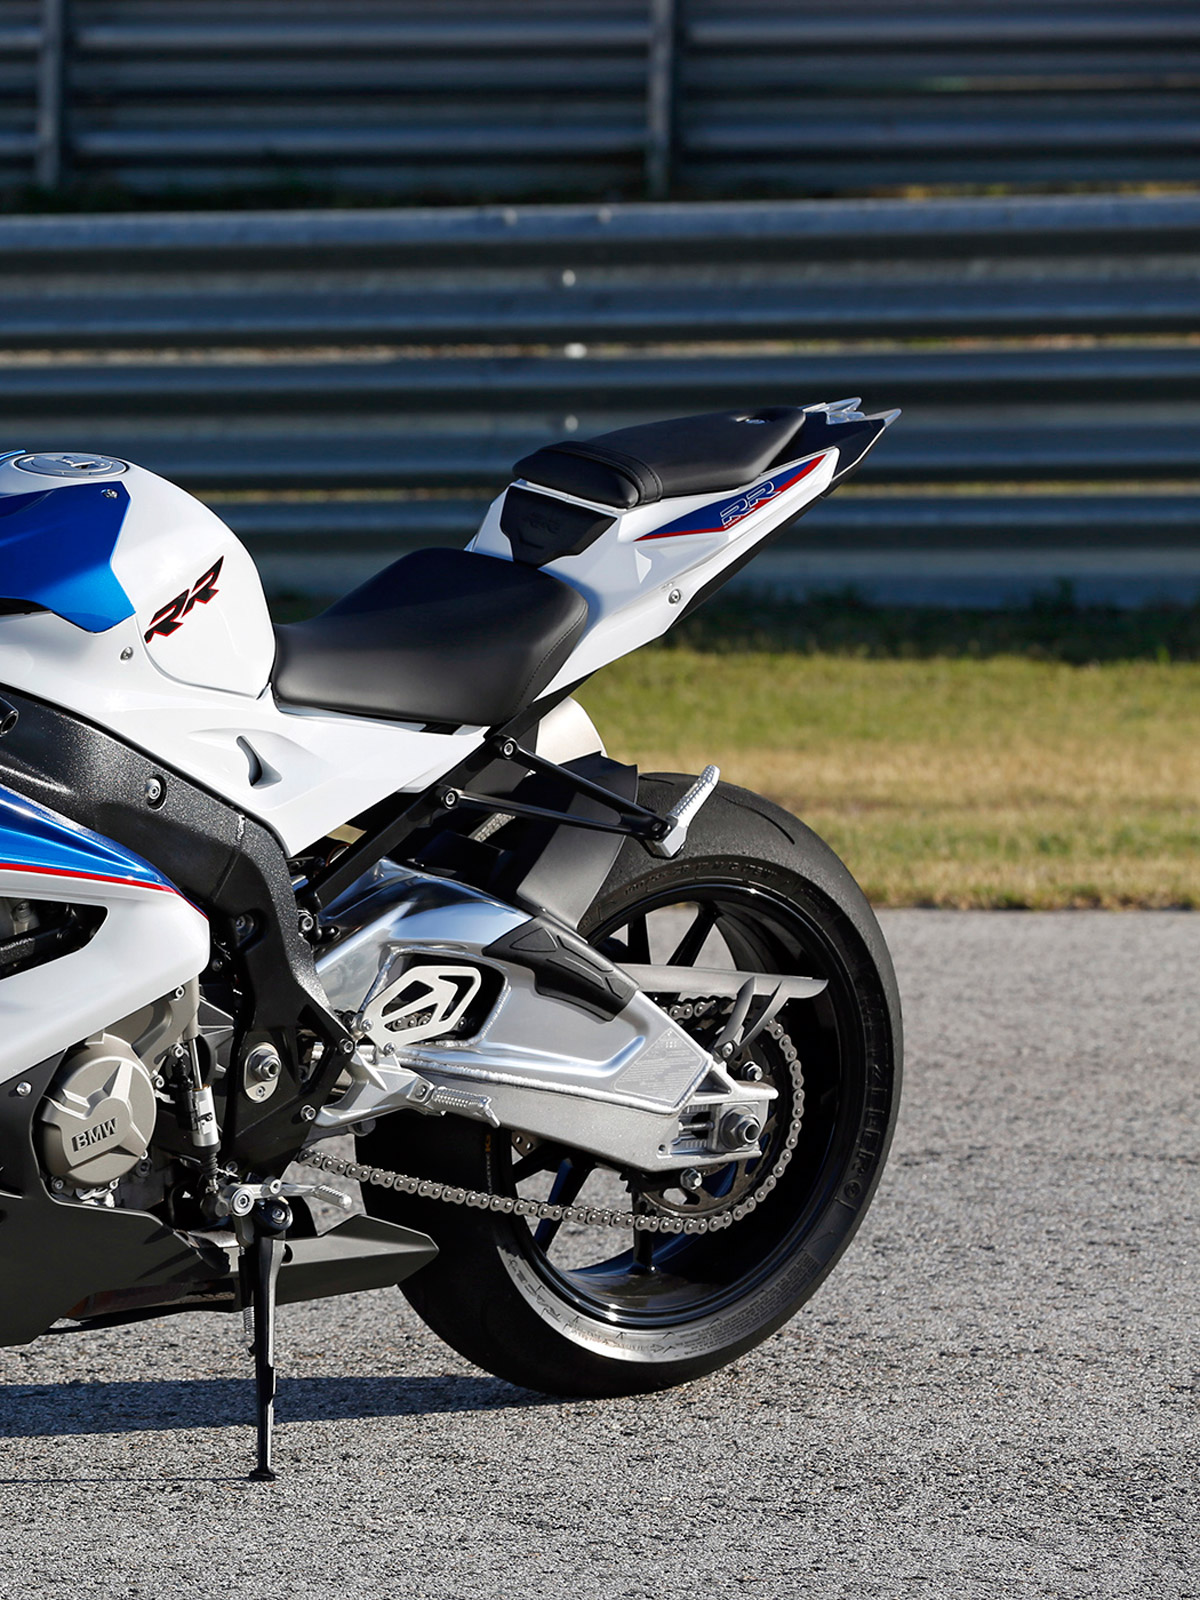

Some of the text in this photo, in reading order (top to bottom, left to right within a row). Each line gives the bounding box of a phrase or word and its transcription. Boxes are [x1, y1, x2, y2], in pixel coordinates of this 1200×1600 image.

[719, 480, 781, 526] RR
[143, 554, 224, 644] RR
[71, 1116, 119, 1153] BMW
